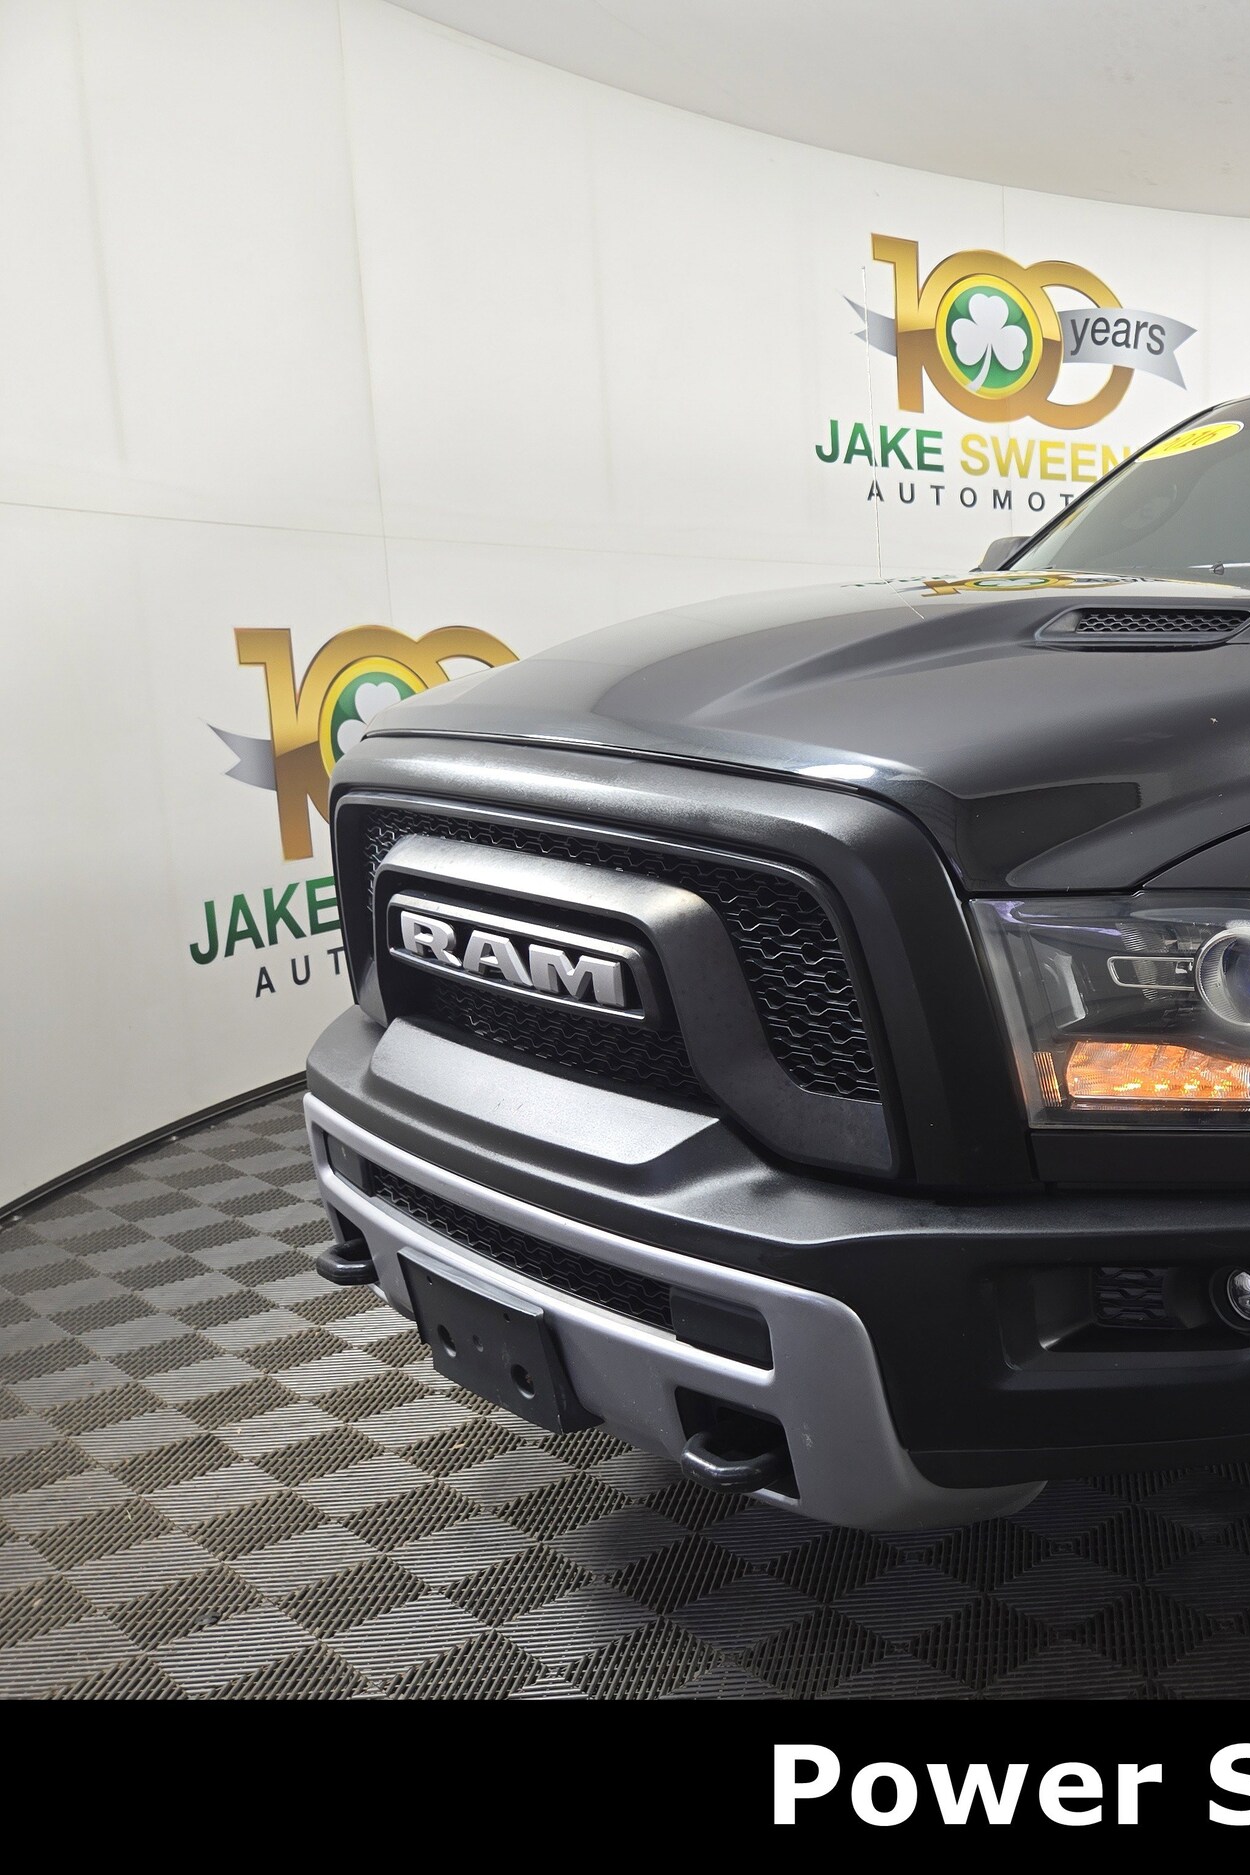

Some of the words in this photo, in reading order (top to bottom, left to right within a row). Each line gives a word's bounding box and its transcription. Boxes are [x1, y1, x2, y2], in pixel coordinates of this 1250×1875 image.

[1069, 316, 1165, 356] years
[815, 418, 945, 473] JAKE
[959, 432, 1130, 484] SWEEN
[867, 479, 1074, 512] AUTOMOT
[189, 875, 342, 966] JAKE
[401, 910, 626, 1008] RAM
